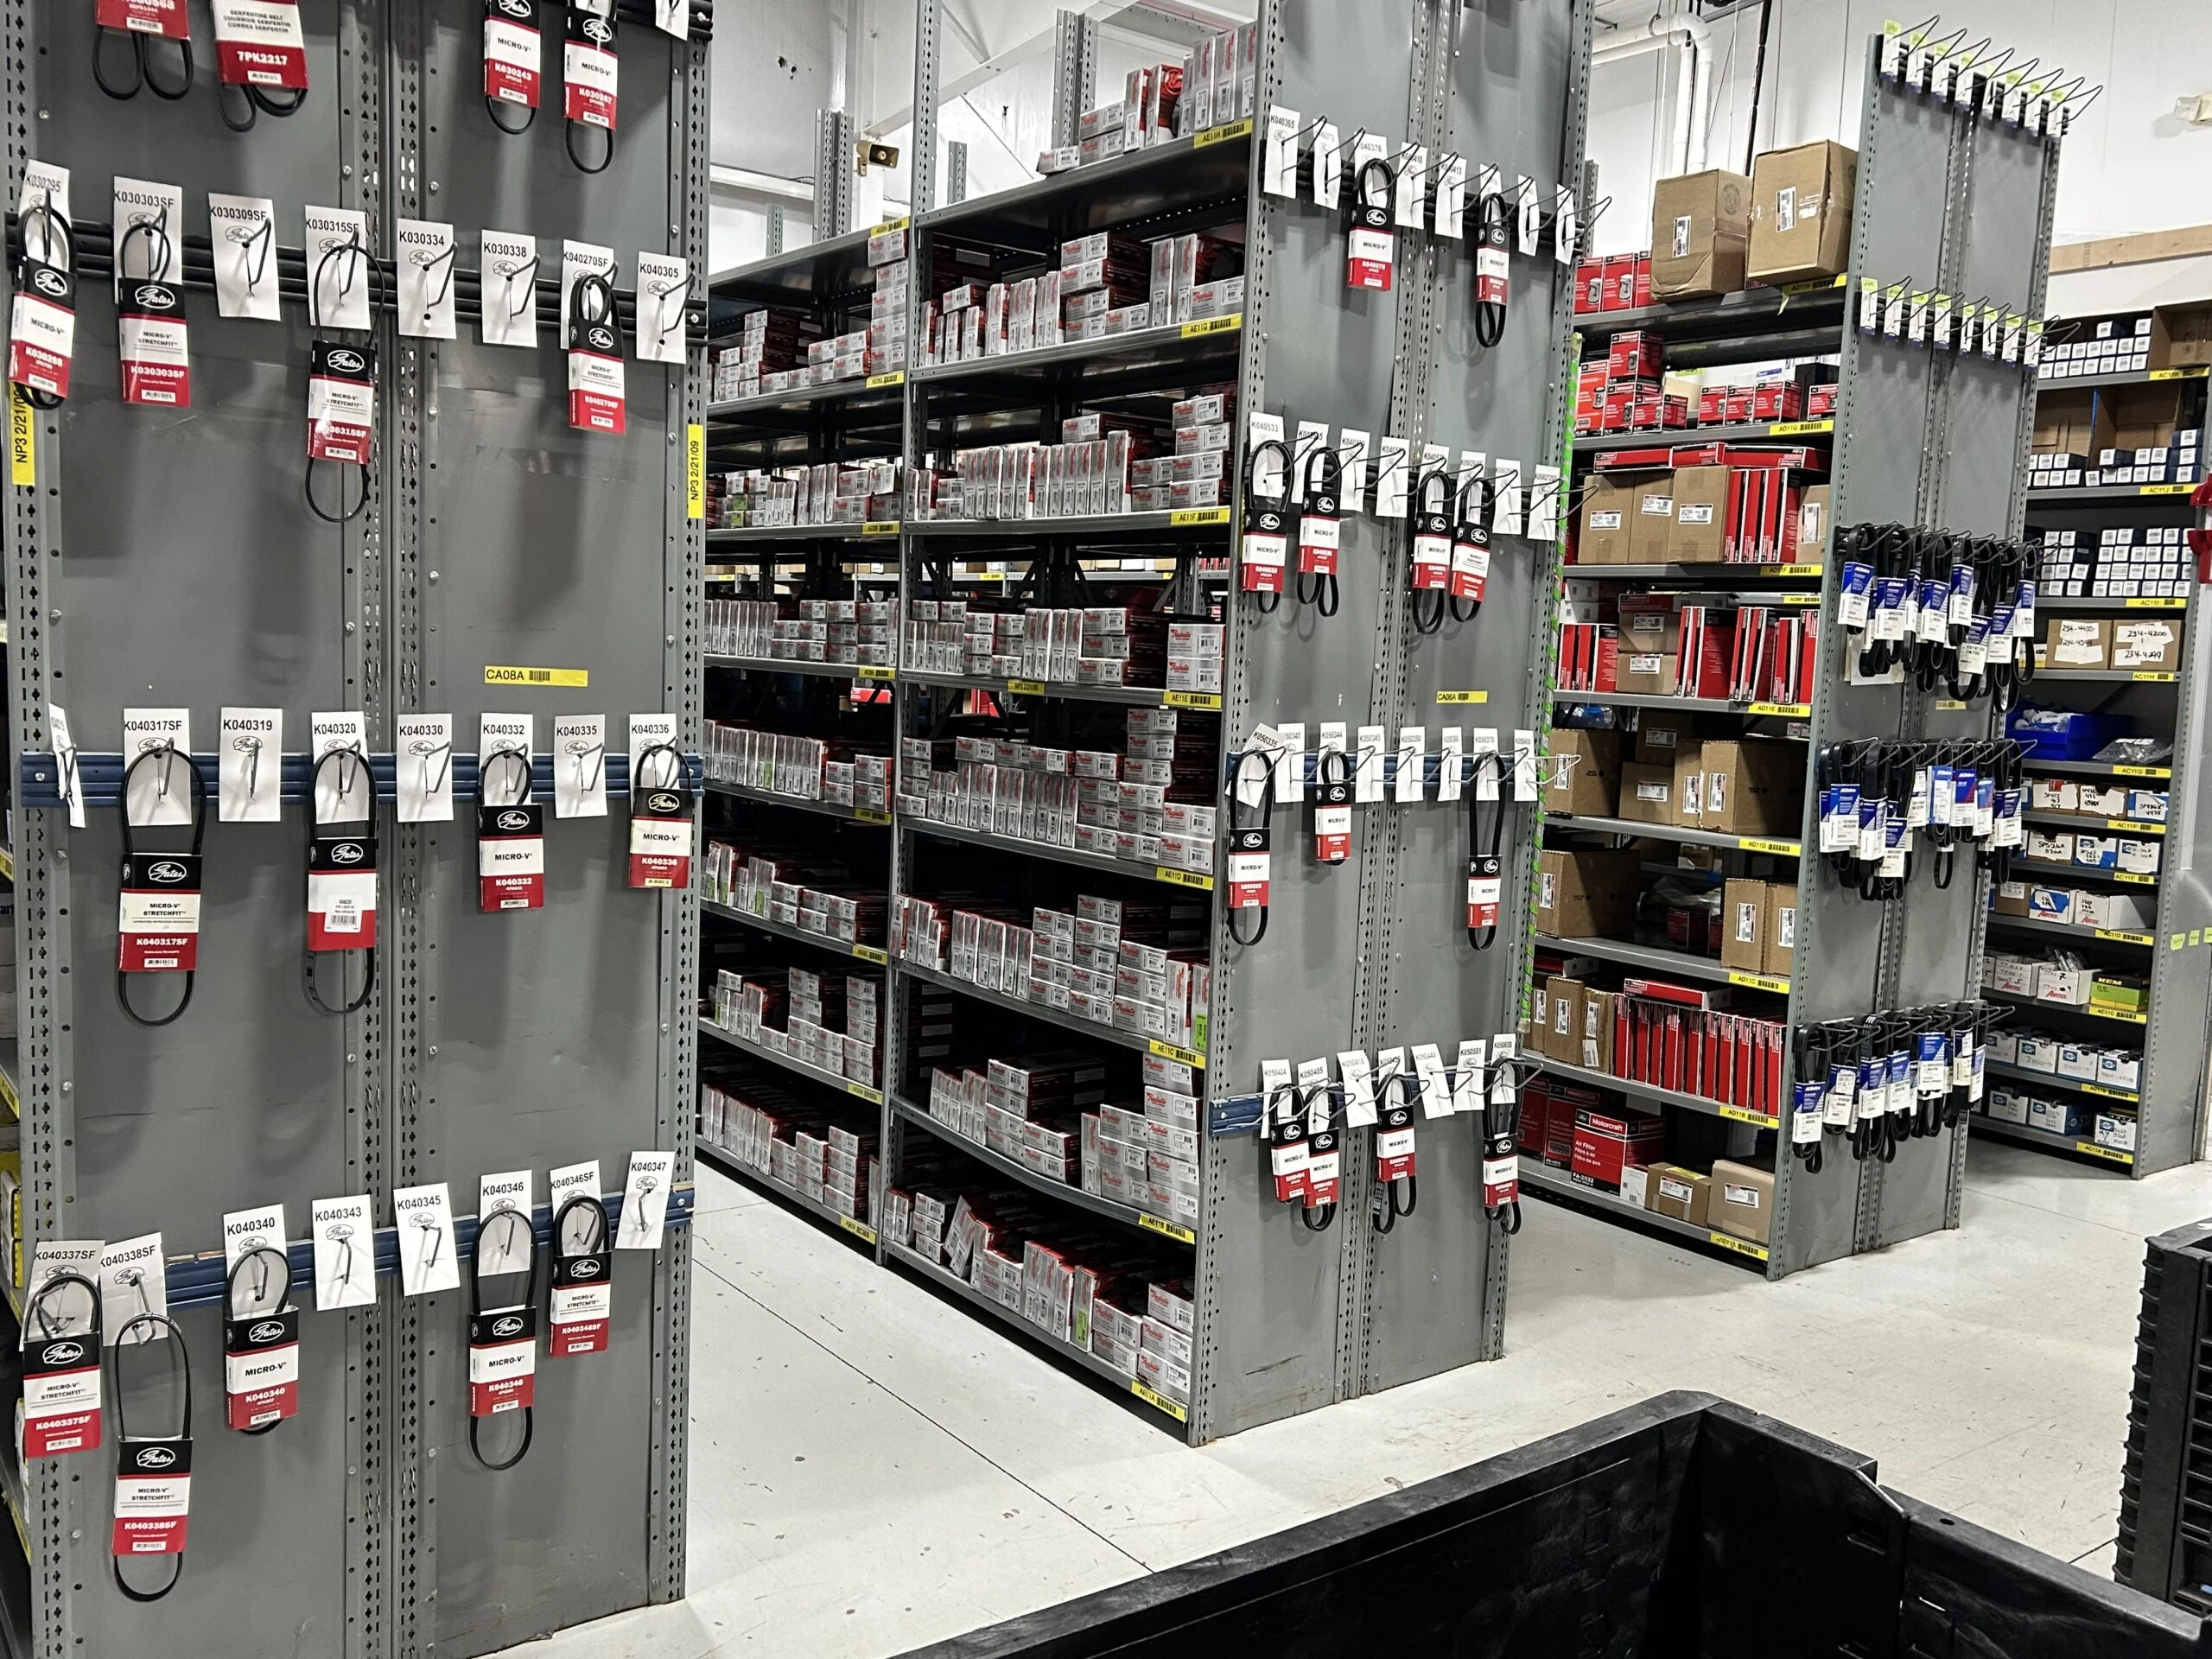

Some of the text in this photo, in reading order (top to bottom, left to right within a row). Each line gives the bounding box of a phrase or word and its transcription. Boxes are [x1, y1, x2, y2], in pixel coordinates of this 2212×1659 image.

[236, 50, 288, 66] 7PK2217
[494, 63, 532, 81] K030243
[1270, 114, 1295, 129] K040365
[115, 189, 174, 210] K030303SF
[210, 207, 267, 221] K030309SF
[305, 218, 359, 233] K030315SF
[398, 231, 445, 246] K030334
[483, 242, 527, 257] K030338
[563, 251, 608, 268] K040270SF
[639, 264, 679, 278] K040305
[35, 270, 67, 296] Gates
[136, 286, 175, 308] Gates
[25, 346, 63, 368] K030295
[327, 351, 364, 371] Gates
[130, 365, 185, 378] K030303SF
[321, 425, 367, 439] 030315SF
[1251, 421, 1279, 433] K040533
[1778, 423, 1798, 433] AD11G
[15, 435, 28, 464] NP3
[690, 440, 699, 500] NP3 2/21/09
[2148, 486, 2170, 494] AC11J
[1179, 512, 1197, 522] AE11F
[486, 670, 524, 681] CA08A
[1171, 694, 1189, 702] AE11E
[124, 720, 182, 732] K040317SF
[222, 719, 273, 732] K040319
[314, 722, 356, 735] K040320
[399, 724, 443, 736] K040330
[483, 724, 524, 735] K040332
[556, 725, 597, 736] K040335
[631, 724, 670, 734] K040336
[1253, 730, 1279, 748] K050335
[649, 793, 679, 811] Gates
[498, 811, 529, 830] Gates
[643, 833, 677, 842] MICRO-V
[1748, 840, 1767, 849] AD11D
[331, 843, 363, 864] Gates
[494, 853, 530, 861] MICRO-V
[641, 857, 677, 866] K040336
[148, 861, 187, 882] Gates
[1164, 870, 1182, 880] AE11D
[495, 877, 532, 887] K040332
[136, 938, 188, 947] K040317SF
[1738, 976, 1756, 985] AD11C
[2097, 977, 2123, 986] KEM
[2097, 1007, 2115, 1016] AC11C
[1157, 1044, 1175, 1056] AE11C
[1592, 1117, 1624, 1132] Motorcraft
[1582, 1141, 1597, 1151] Filter
[2084, 1145, 2102, 1154] AC11A
[631, 1161, 667, 1172] K040347
[550, 1172, 594, 1190] K040346SF
[482, 1181, 524, 1197] K040346
[397, 1195, 442, 1211] K040345
[315, 1206, 362, 1222] K040343
[226, 1217, 276, 1236] K040340
[35, 1249, 96, 1262] K040337SF
[100, 1244, 156, 1268] K040338SF
[570, 1259, 601, 1277] Gates
[250, 1321, 285, 1342] Gates
[493, 1317, 524, 1336] Gates
[562, 1323, 601, 1335] K040346SF
[43, 1342, 84, 1364] Gates
[245, 1361, 284, 1376] MICRO-V
[488, 1355, 523, 1368] MICRO-V
[488, 1378, 524, 1393] K040346
[245, 1387, 286, 1403] K040340
[35, 1415, 91, 1431] K040337SF
[137, 1447, 176, 1468] Gates
[124, 1521, 176, 1530] K040338SF
